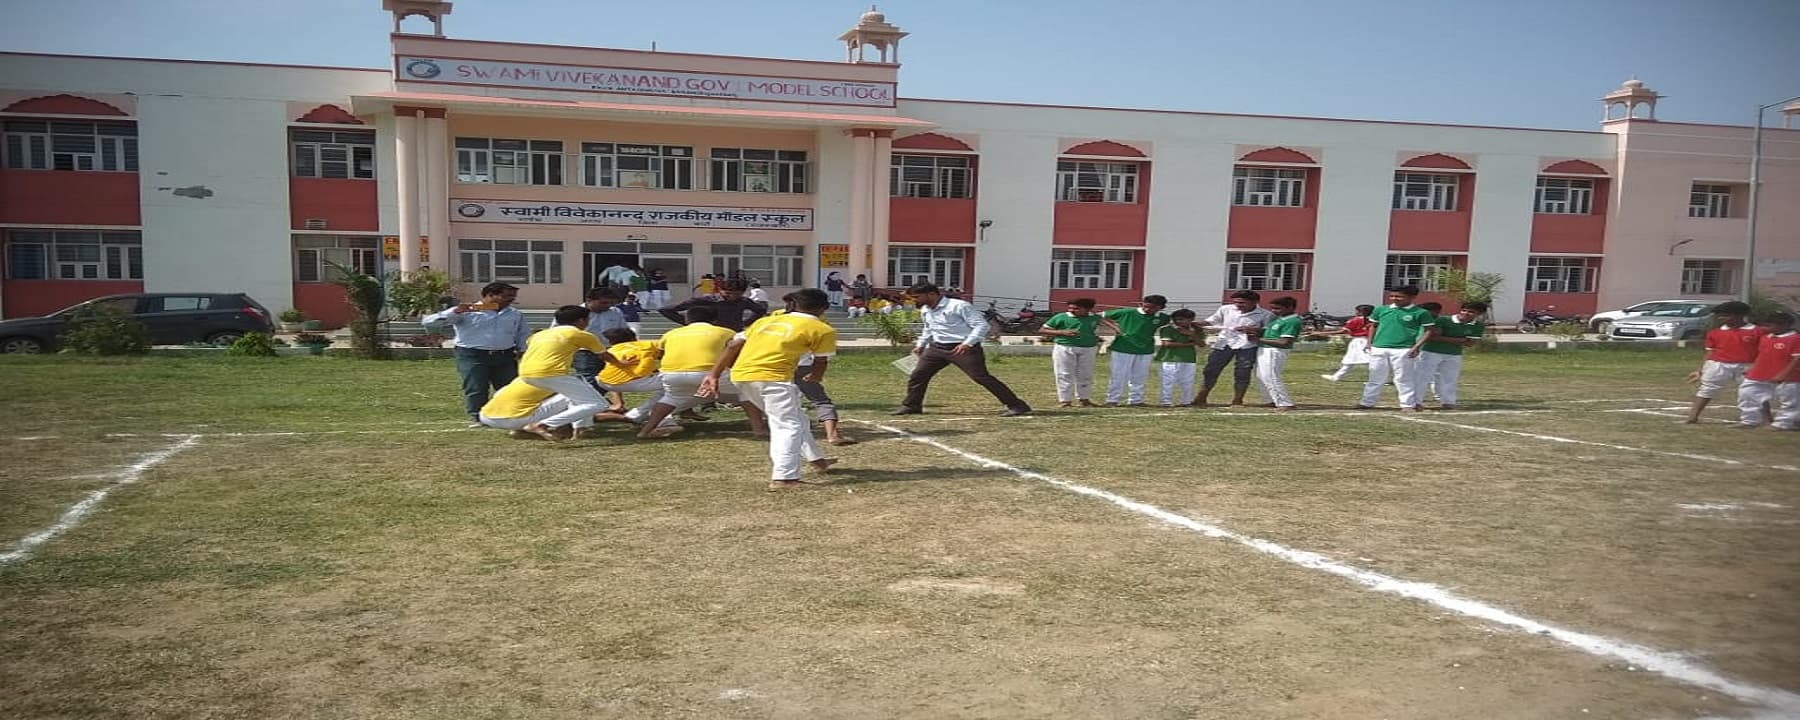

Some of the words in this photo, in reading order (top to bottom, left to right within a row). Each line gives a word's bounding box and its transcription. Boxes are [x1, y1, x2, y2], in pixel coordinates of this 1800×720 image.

[546, 69, 681, 90] VIVEKANAND
[748, 80, 816, 97] MODEL
[819, 84, 889, 100] SCHOOL
[499, 205, 552, 218] स्वामी
[553, 206, 644, 220] विवेकानन्द
[647, 209, 713, 221] राजकीय
[760, 213, 806, 225] स्कूल
